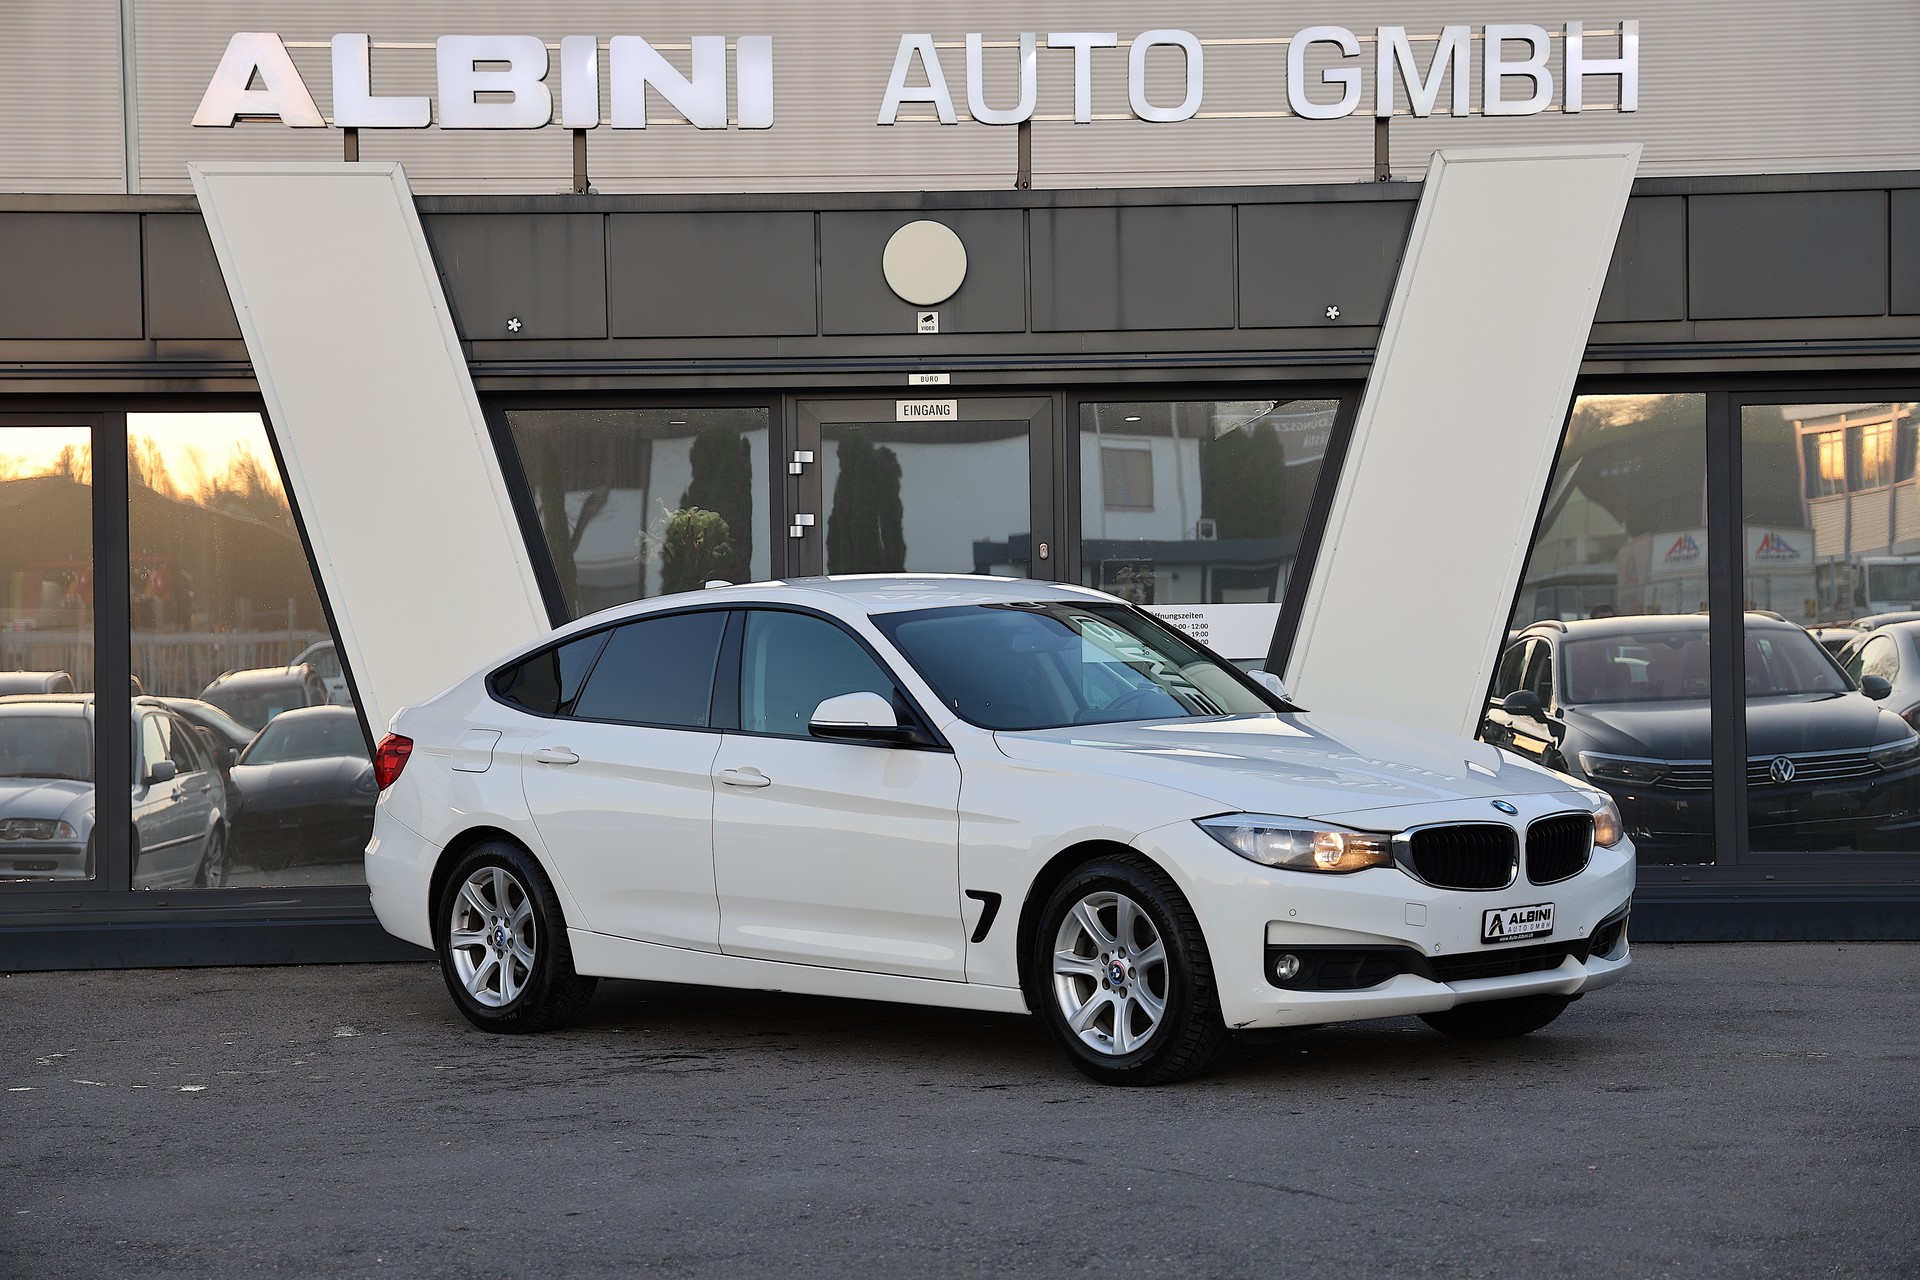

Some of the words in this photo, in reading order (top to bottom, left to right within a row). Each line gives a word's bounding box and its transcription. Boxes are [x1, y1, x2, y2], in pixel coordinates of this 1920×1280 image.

[191, 32, 774, 130] ALBINI
[877, 29, 1204, 126] AUTO
[1286, 20, 1640, 120] GMBH
[903, 405, 950, 416] EINGANG
[1150, 612, 1204, 620] ffnungszeiten
[1509, 908, 1551, 925] ALBINI
[1508, 924, 1527, 932] AUTO
[1530, 921, 1550, 930] GMBH
